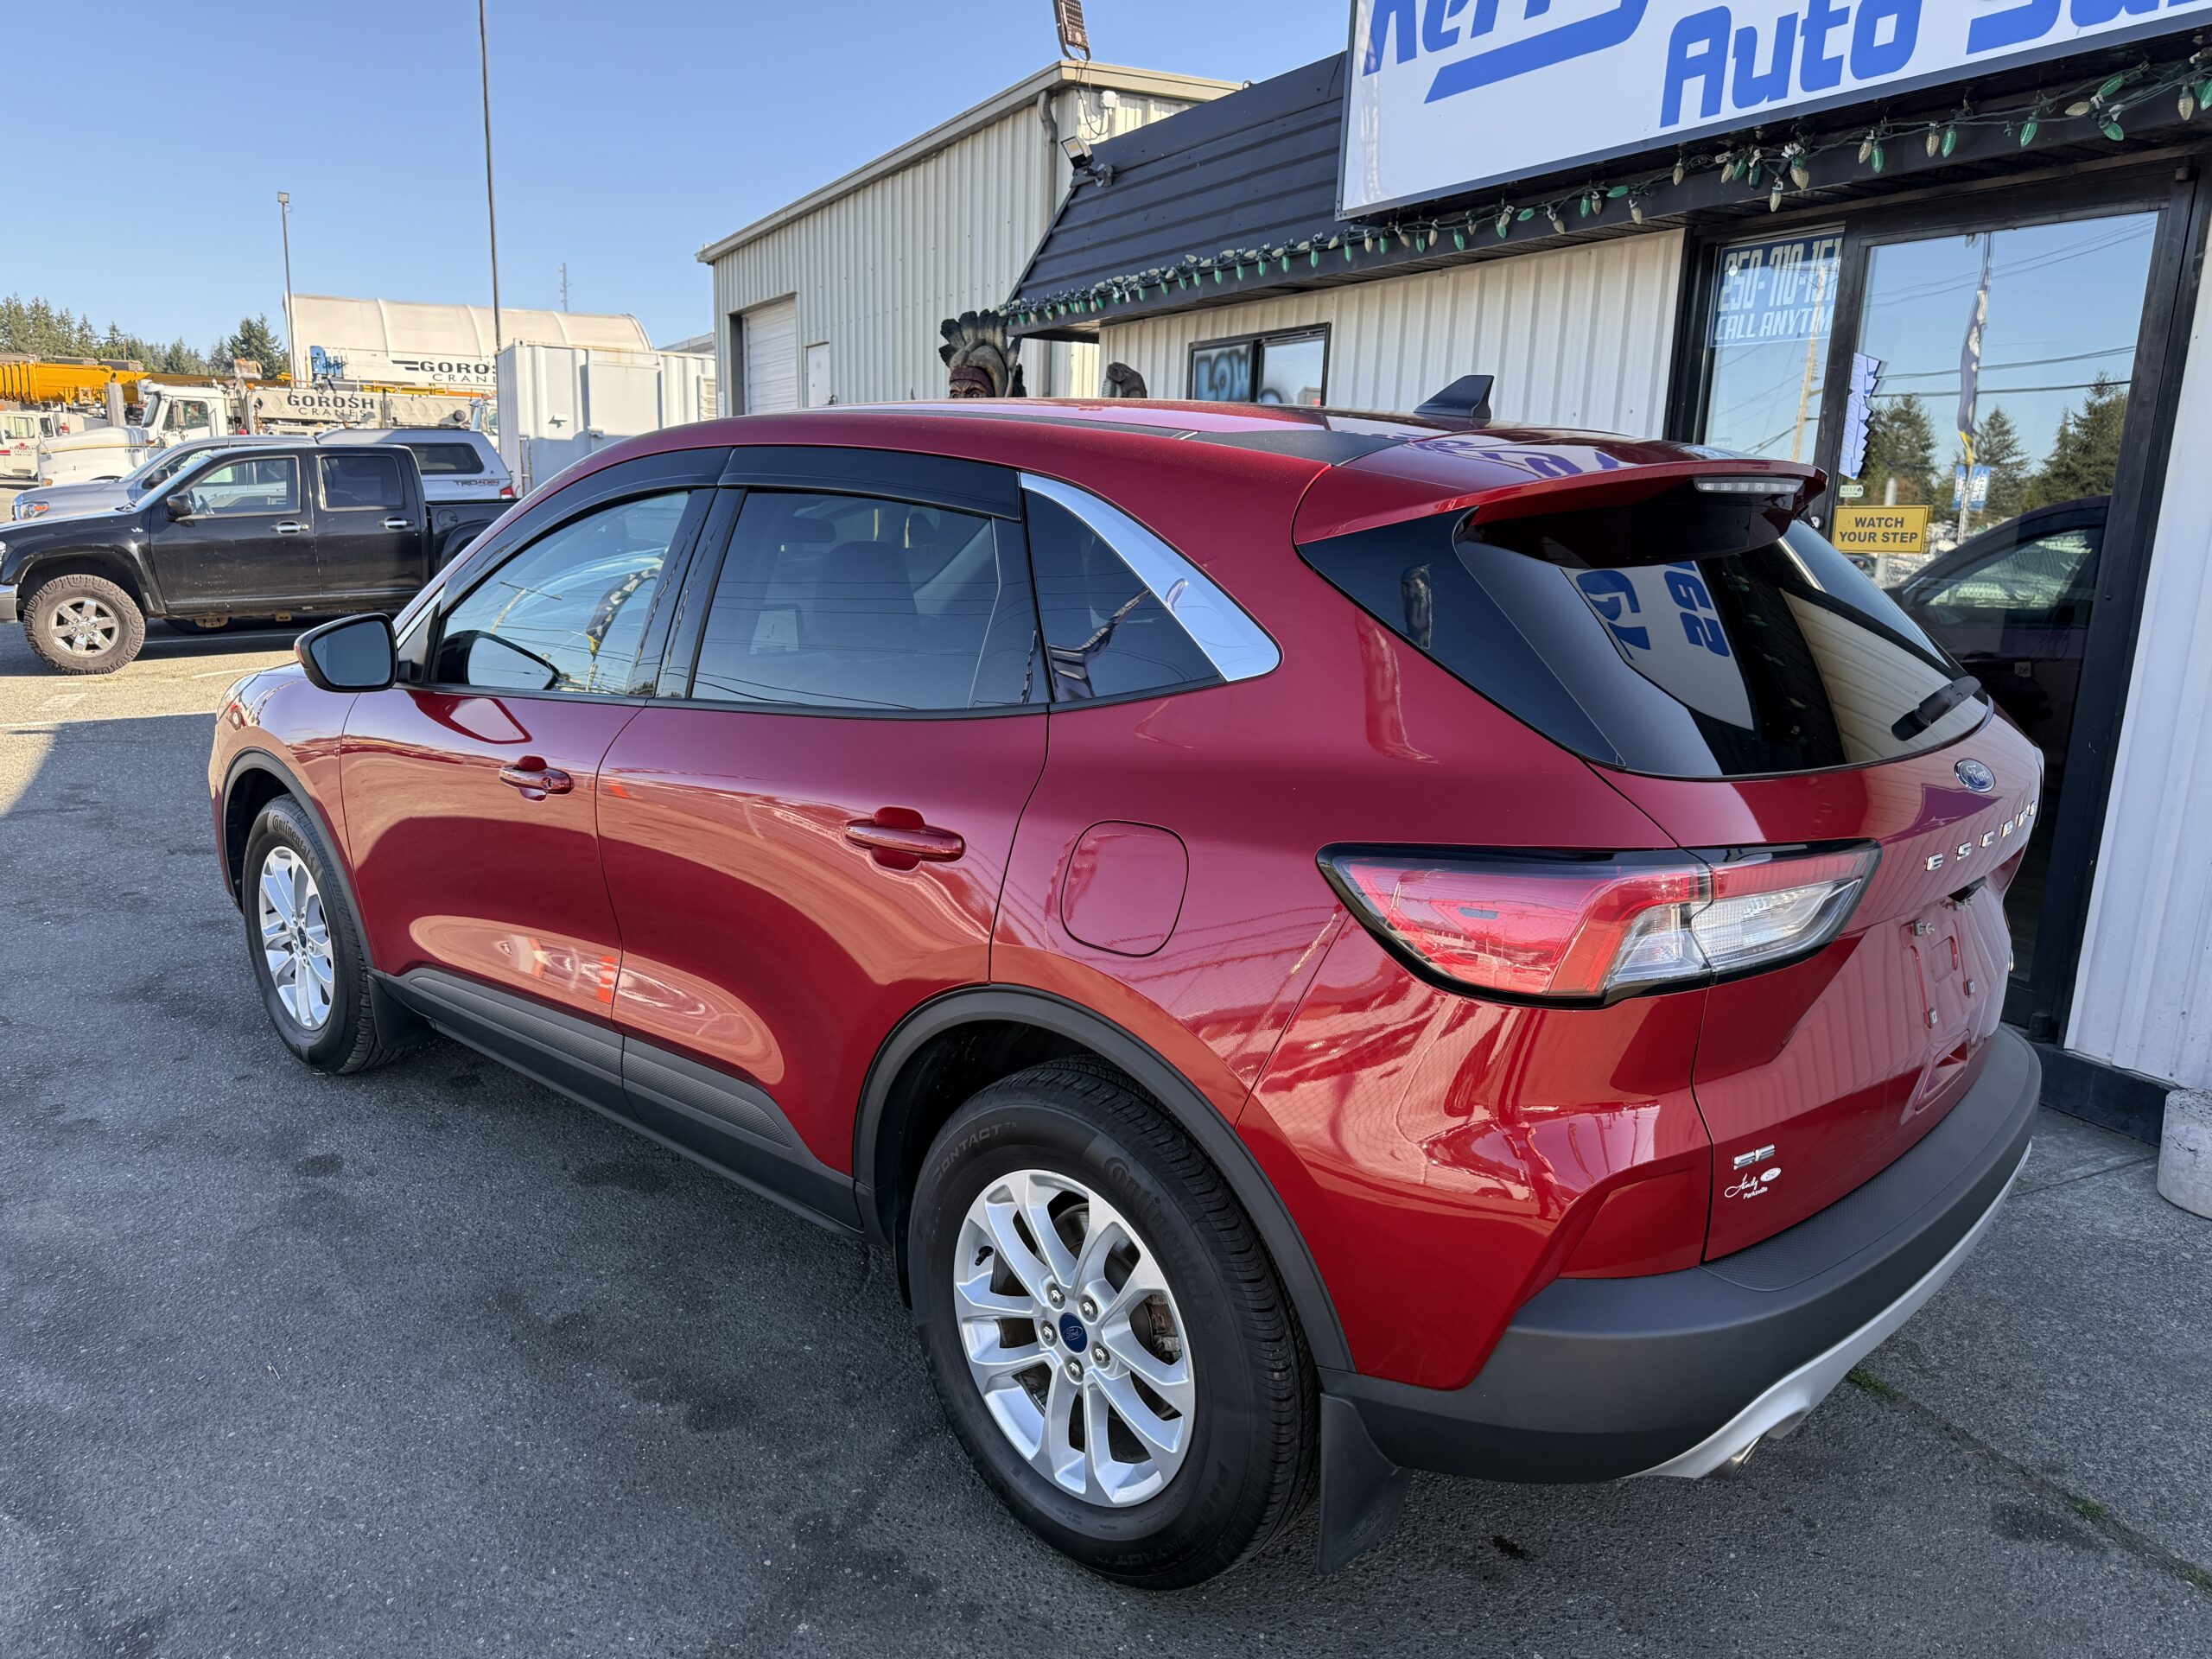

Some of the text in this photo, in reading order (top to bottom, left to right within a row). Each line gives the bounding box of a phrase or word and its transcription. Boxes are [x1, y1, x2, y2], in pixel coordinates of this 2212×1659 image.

[1660, 0, 1923, 129] Auto
[1718, 238, 1842, 311] 250-710-151
[1714, 314, 1756, 340] CALL
[1195, 346, 1251, 401] LOW
[287, 395, 374, 409] GOROSH
[298, 407, 366, 417] CRANES
[1854, 517, 1904, 528] WATCH
[1839, 531, 1918, 543] YOUR STEP
[272, 815, 311, 861] Continental
[1732, 1144, 1775, 1170] SE
[1743, 1186, 1768, 1200] Parksville
